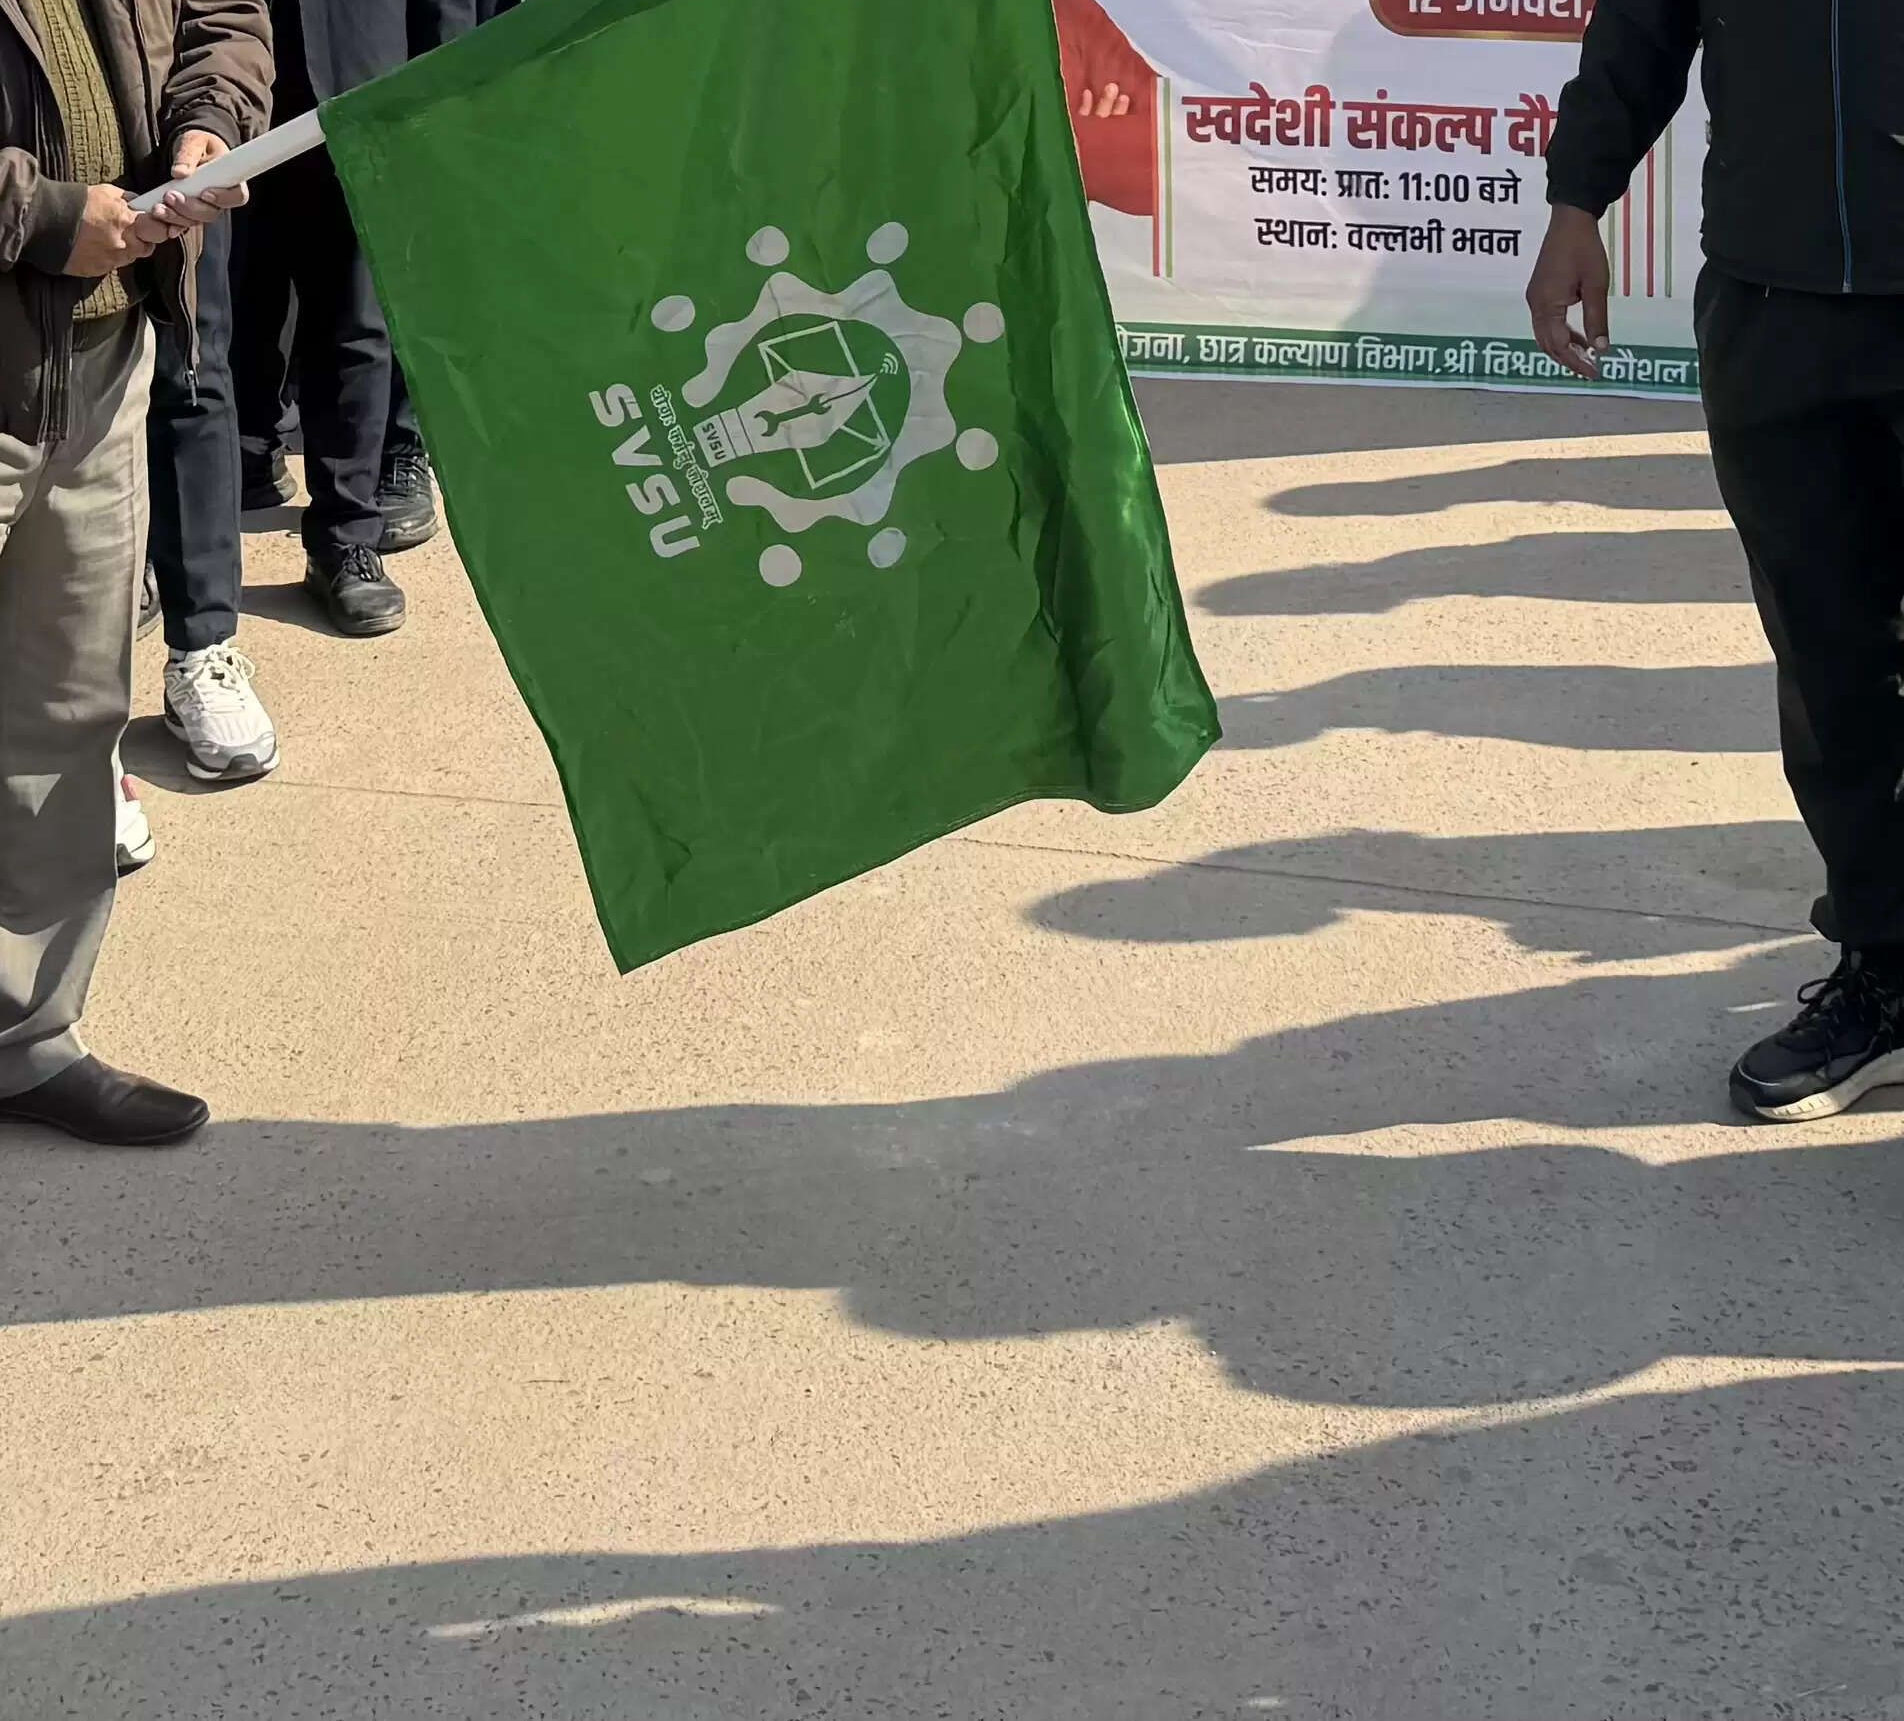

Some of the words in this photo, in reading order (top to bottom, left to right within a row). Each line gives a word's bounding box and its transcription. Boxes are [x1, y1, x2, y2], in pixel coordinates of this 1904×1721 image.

[1181, 82, 1337, 147] स्वदेशी
[1342, 89, 1498, 155] संकल्प
[1504, 93, 1559, 158] दौ
[1398, 171, 1470, 203] 11:00
[1476, 168, 1523, 205] बजे
[1345, 217, 1446, 254] वल्लभी
[1451, 227, 1522, 257] भवन
[1196, 334, 1249, 365] छात्र
[1252, 337, 1351, 369] कल्याण
[1599, 348, 1692, 384] कौशल
[701, 422, 728, 462] SVSU
[588, 383, 701, 558] SVSU
